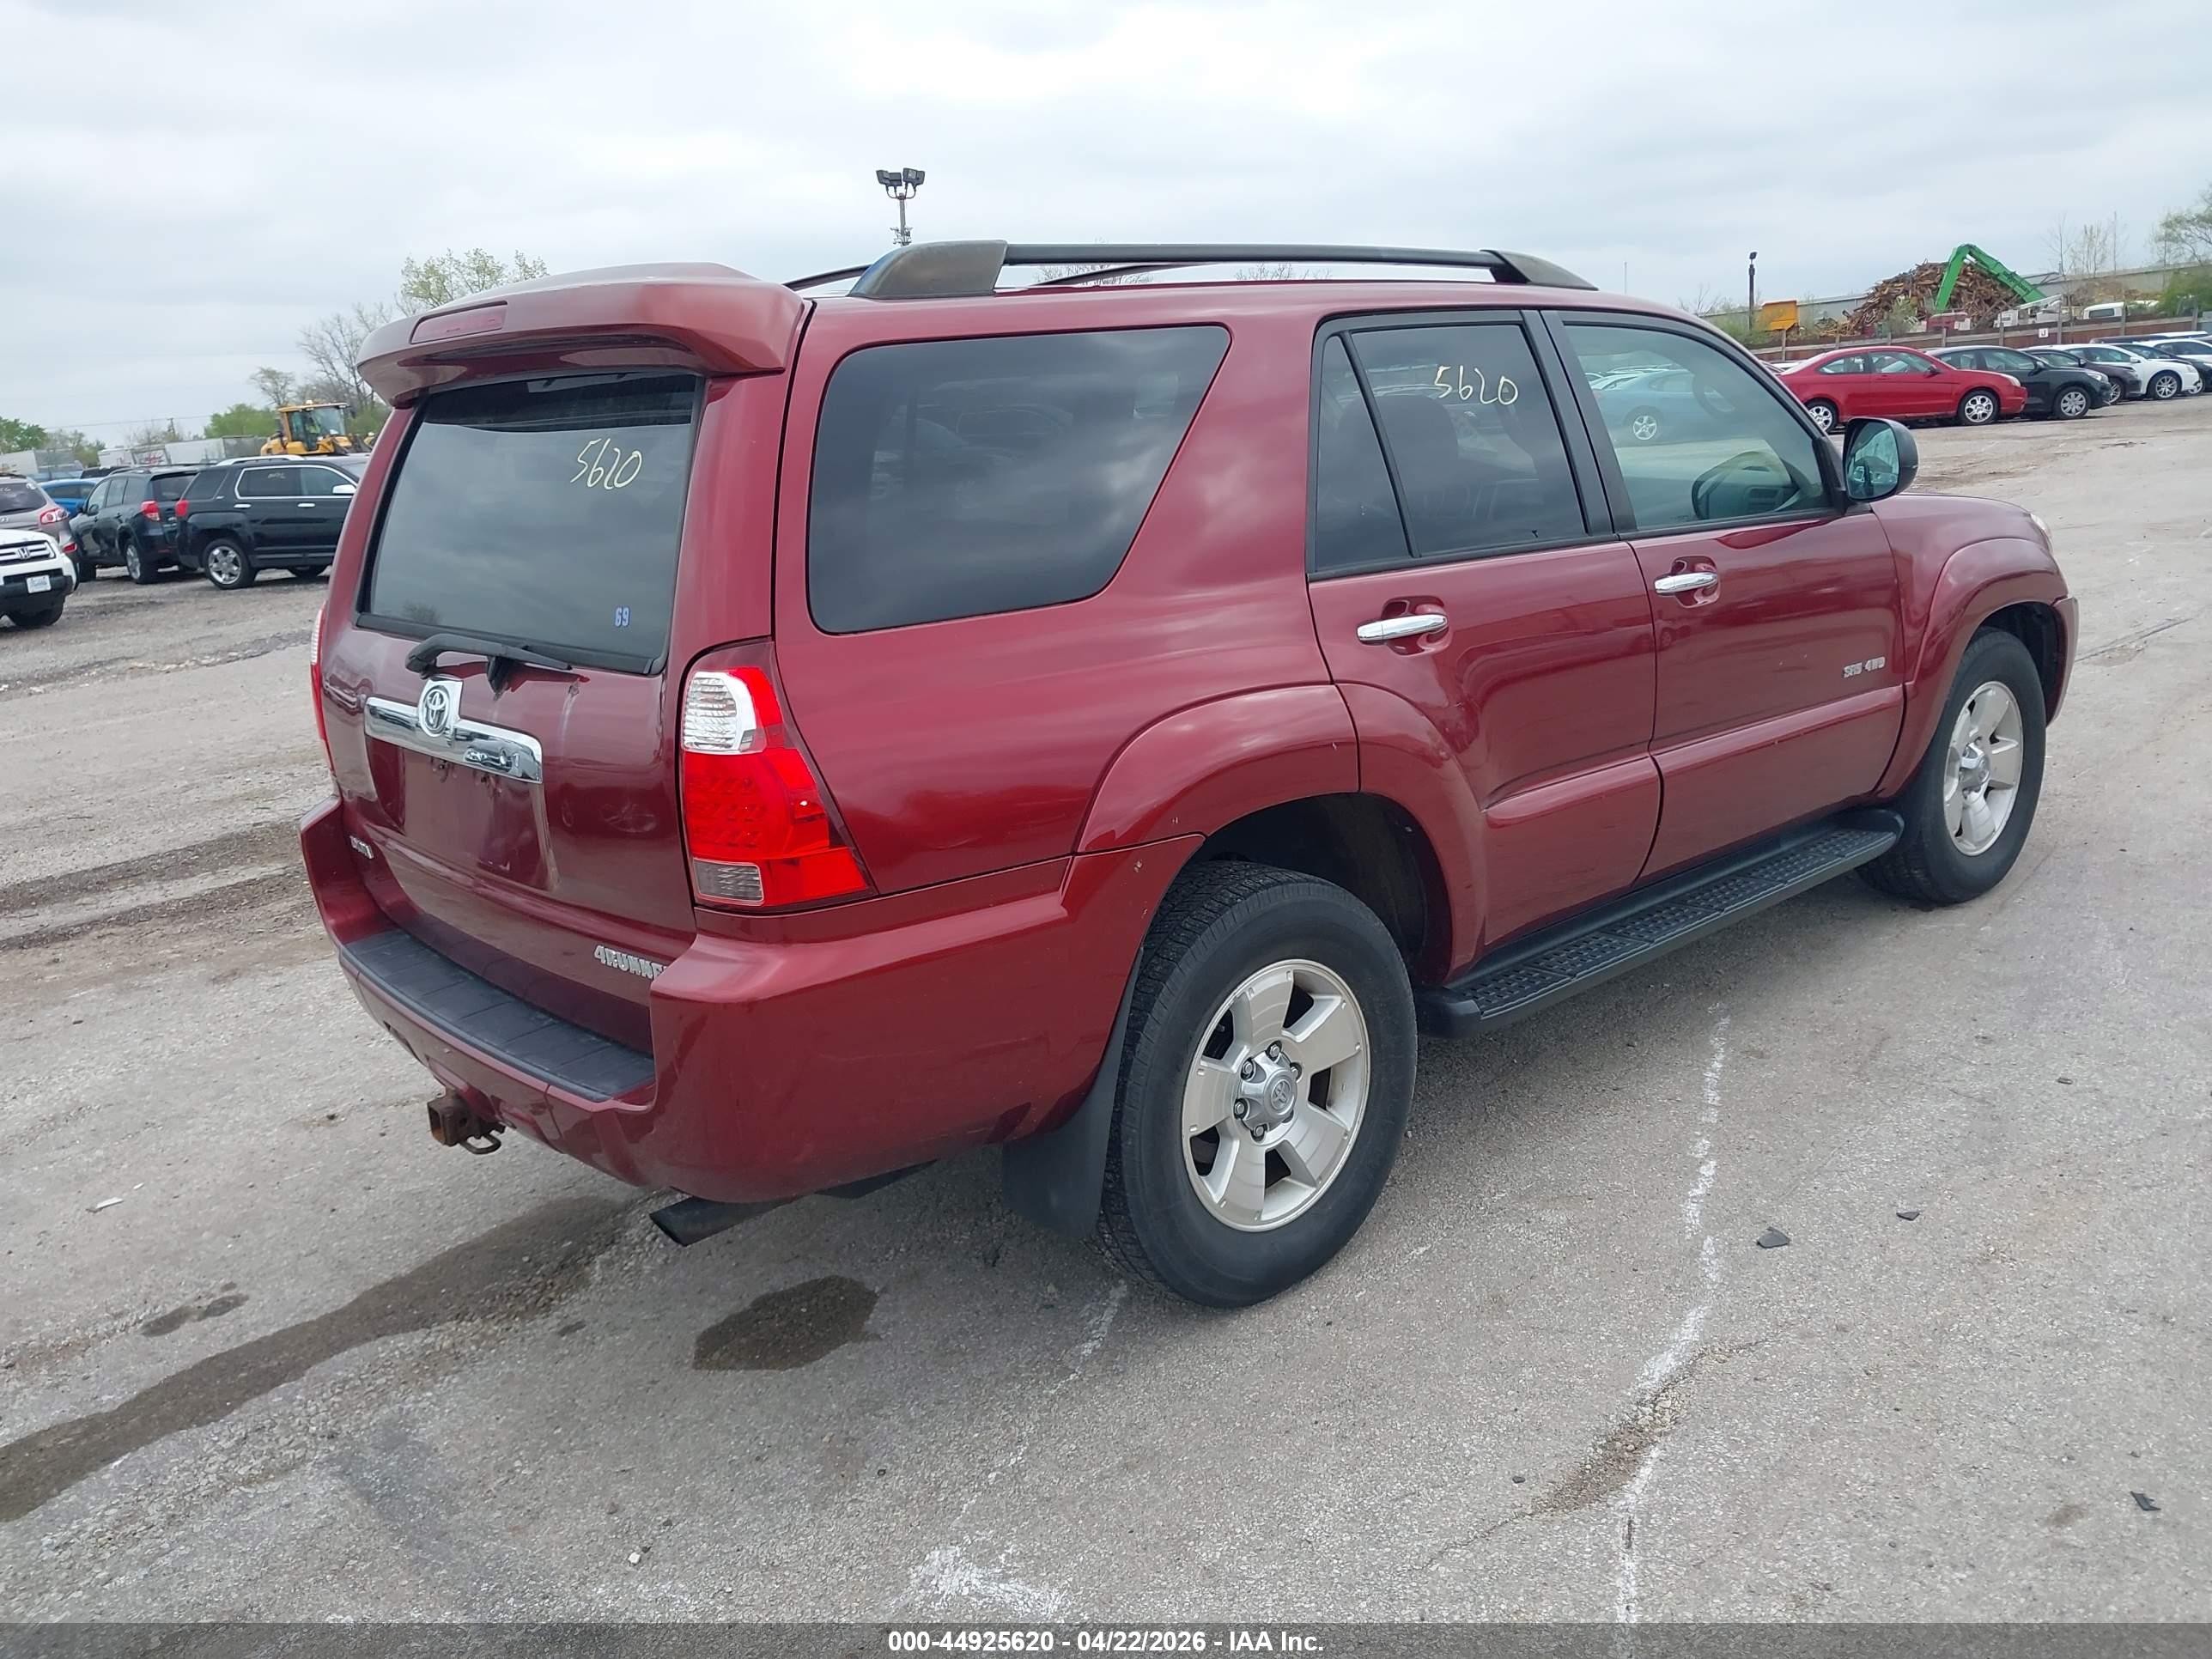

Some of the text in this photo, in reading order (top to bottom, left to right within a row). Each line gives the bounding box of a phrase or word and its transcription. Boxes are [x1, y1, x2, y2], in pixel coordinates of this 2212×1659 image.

[1434, 365, 1518, 405] 5620
[570, 438, 642, 489] 5620
[615, 607, 629, 627] 69
[594, 945, 667, 980] 4RUNNE
